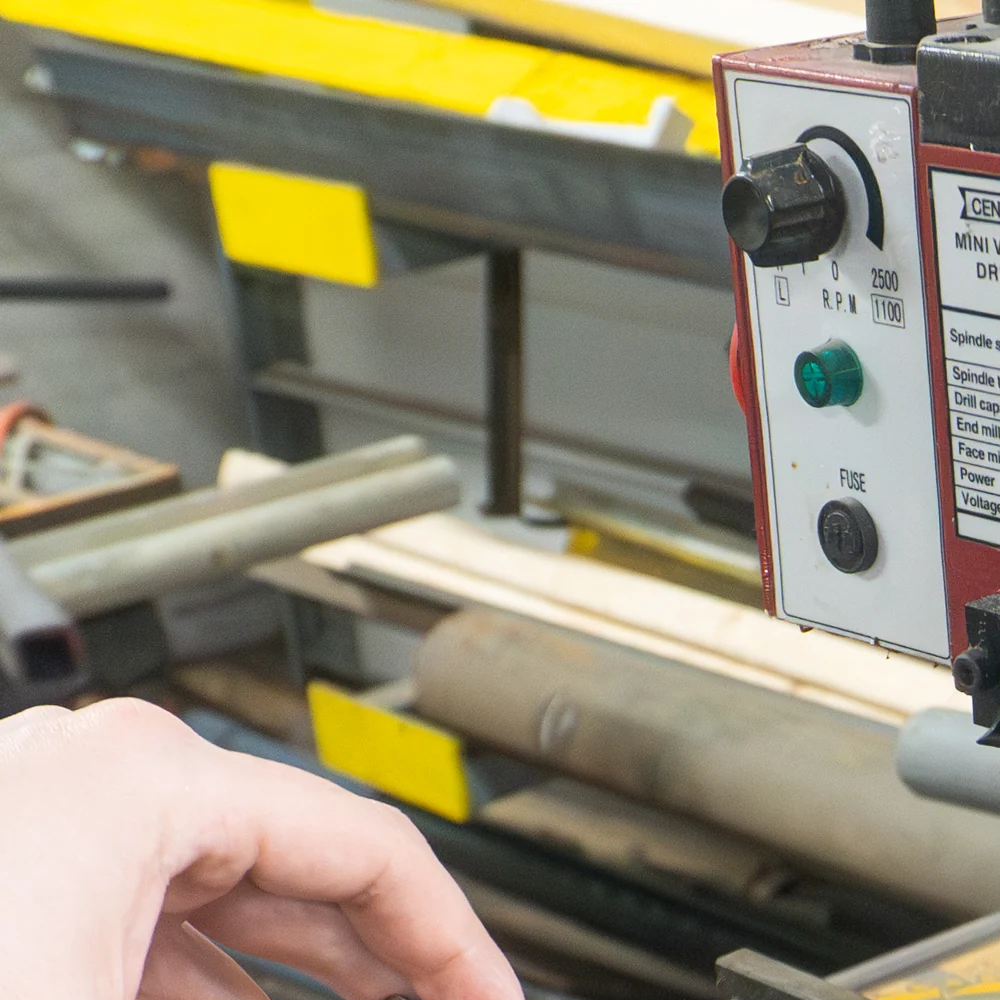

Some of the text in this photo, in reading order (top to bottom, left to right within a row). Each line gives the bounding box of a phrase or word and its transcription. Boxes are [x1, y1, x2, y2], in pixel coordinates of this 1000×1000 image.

[955, 232, 989, 254] MINI
[871, 267, 899, 292] 2500
[874, 300, 902, 323] 1100
[950, 329, 993, 350] Spindle
[952, 366, 995, 387] Spindle
[954, 391, 977, 409] Drill
[956, 416, 979, 435] End
[981, 422, 1000, 440] mill
[958, 441, 985, 460] Face
[839, 468, 867, 493] FUSE
[960, 466, 995, 488] Power
